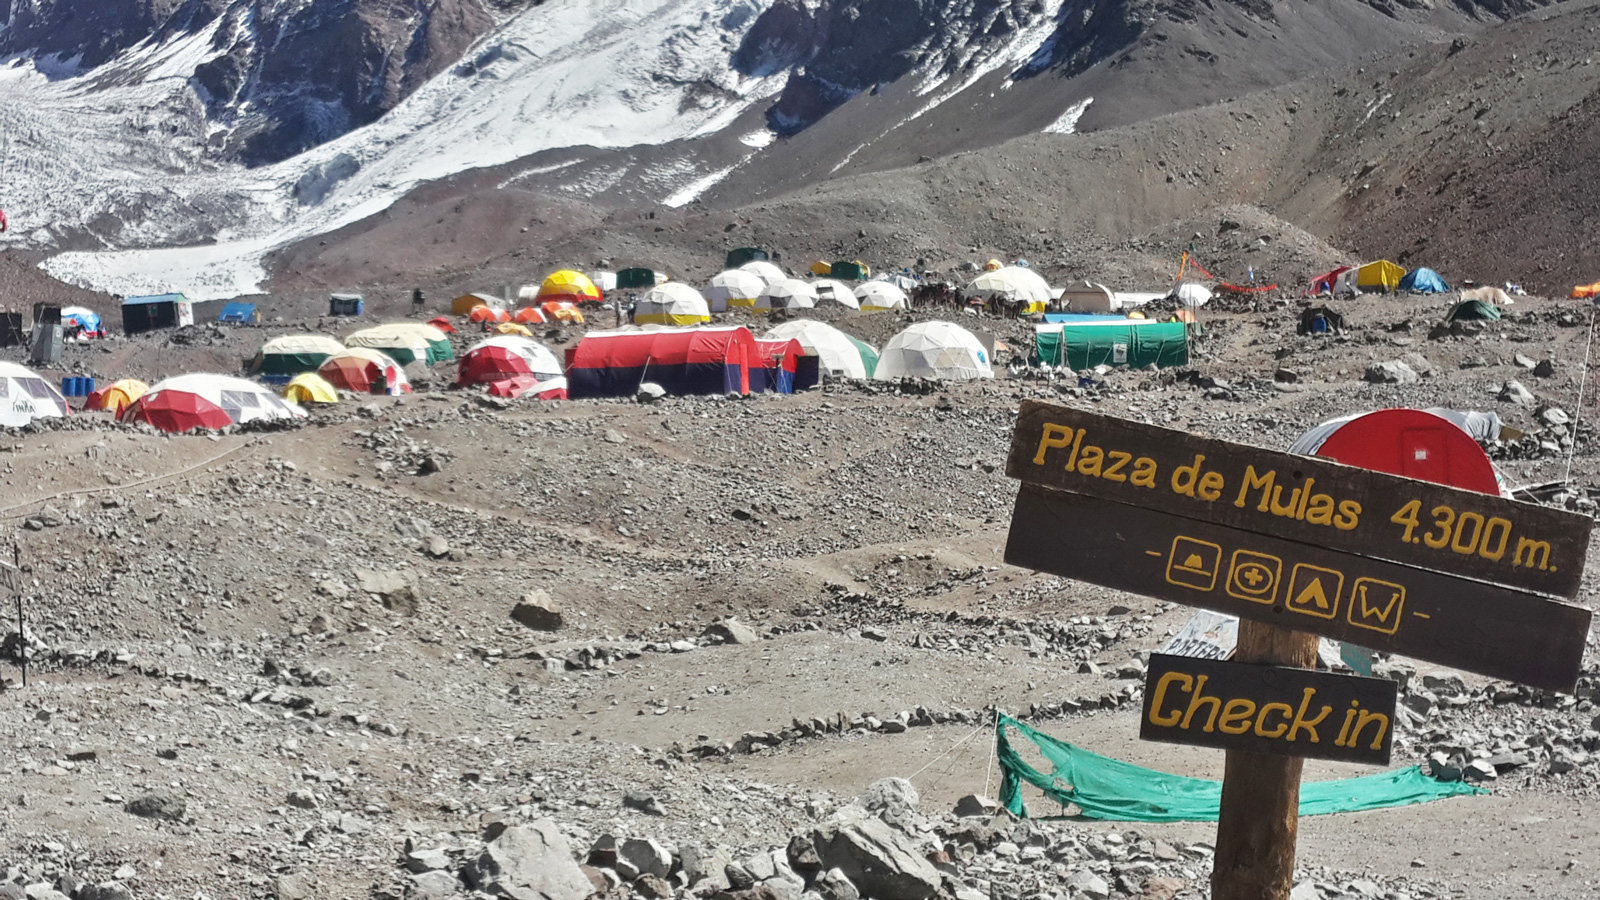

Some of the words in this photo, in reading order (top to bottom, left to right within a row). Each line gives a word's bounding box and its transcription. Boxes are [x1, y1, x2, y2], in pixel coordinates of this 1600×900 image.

[1033, 422, 1157, 489] Plaza
[1171, 454, 1225, 501] de
[1235, 465, 1363, 532] Mulas
[1391, 499, 1513, 561] 4.300
[1513, 536, 1558, 572] m.
[1149, 671, 1333, 743] Check
[1334, 700, 1389, 750] in
